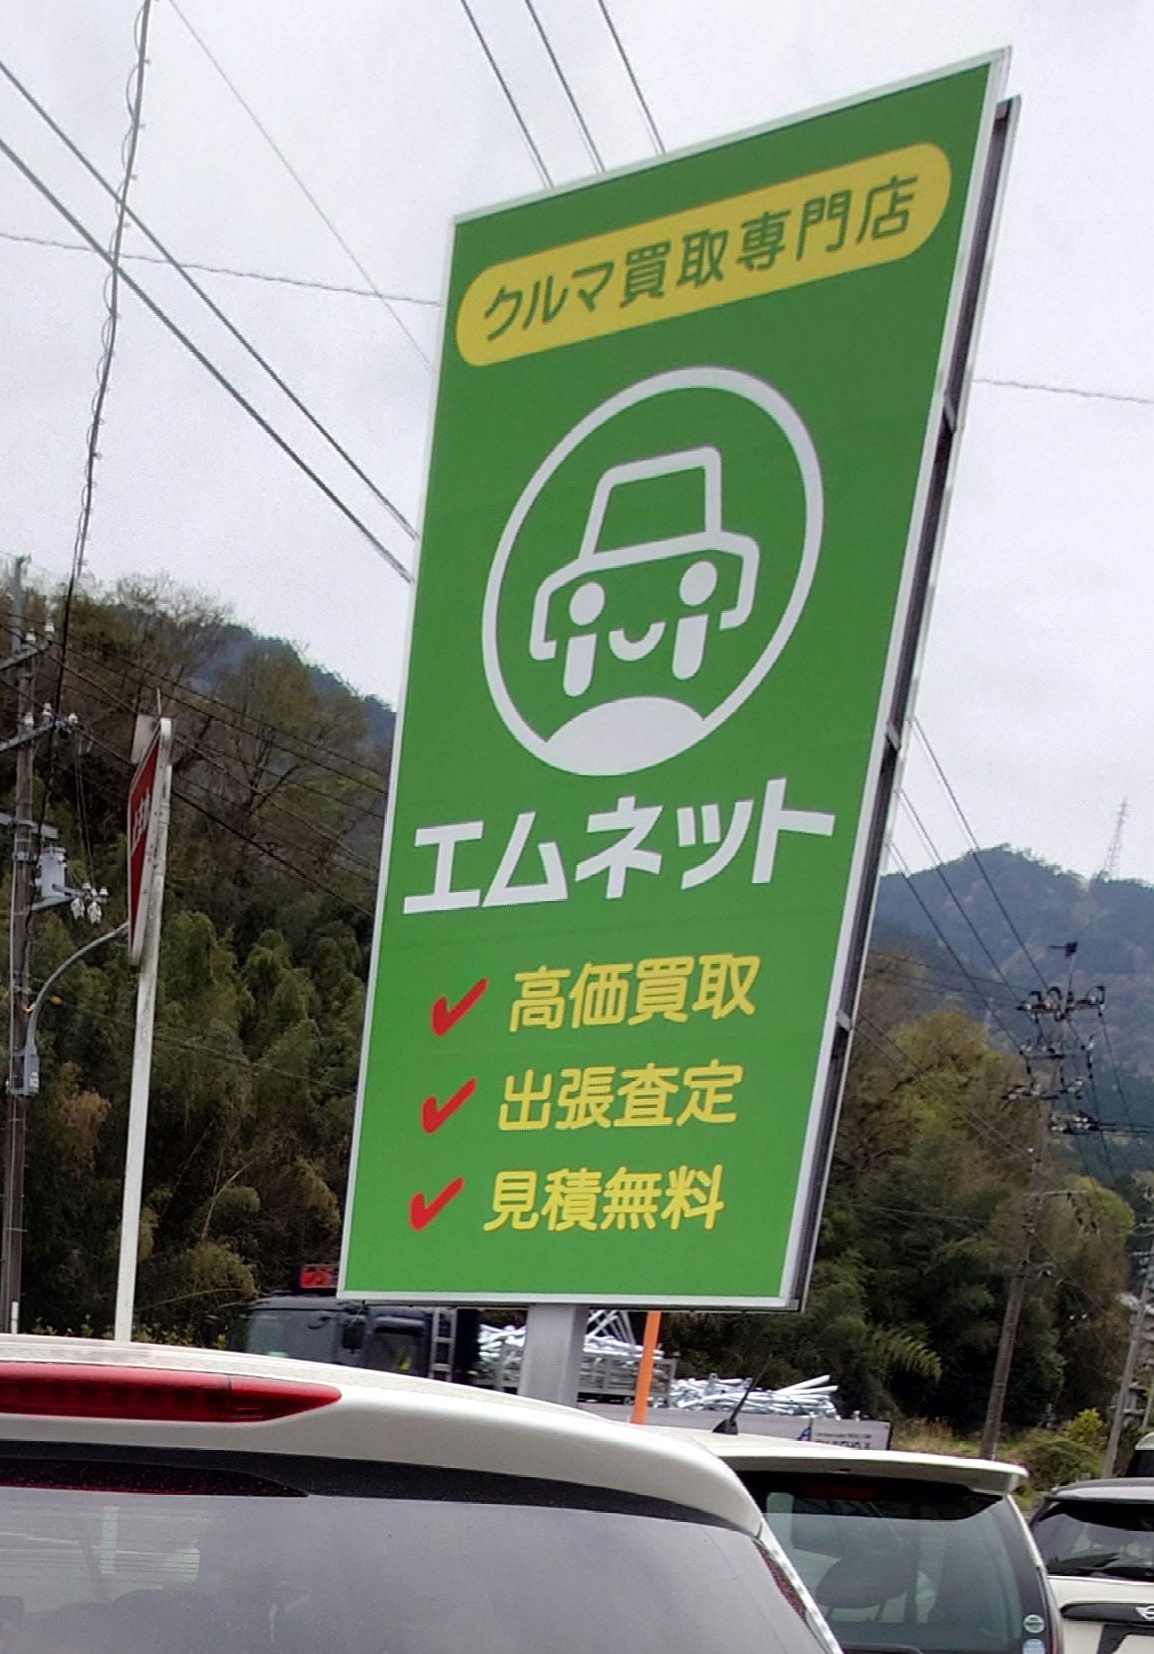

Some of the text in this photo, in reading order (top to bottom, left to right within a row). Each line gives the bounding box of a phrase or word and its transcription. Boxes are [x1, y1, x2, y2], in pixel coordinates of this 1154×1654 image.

[484, 174, 918, 342] クルマ買取専門店
[403, 777, 836, 915] エムネット
[509, 952, 761, 1033] 高価買取
[497, 1059, 743, 1131] 出張査定
[483, 1164, 725, 1233] 見積無料
